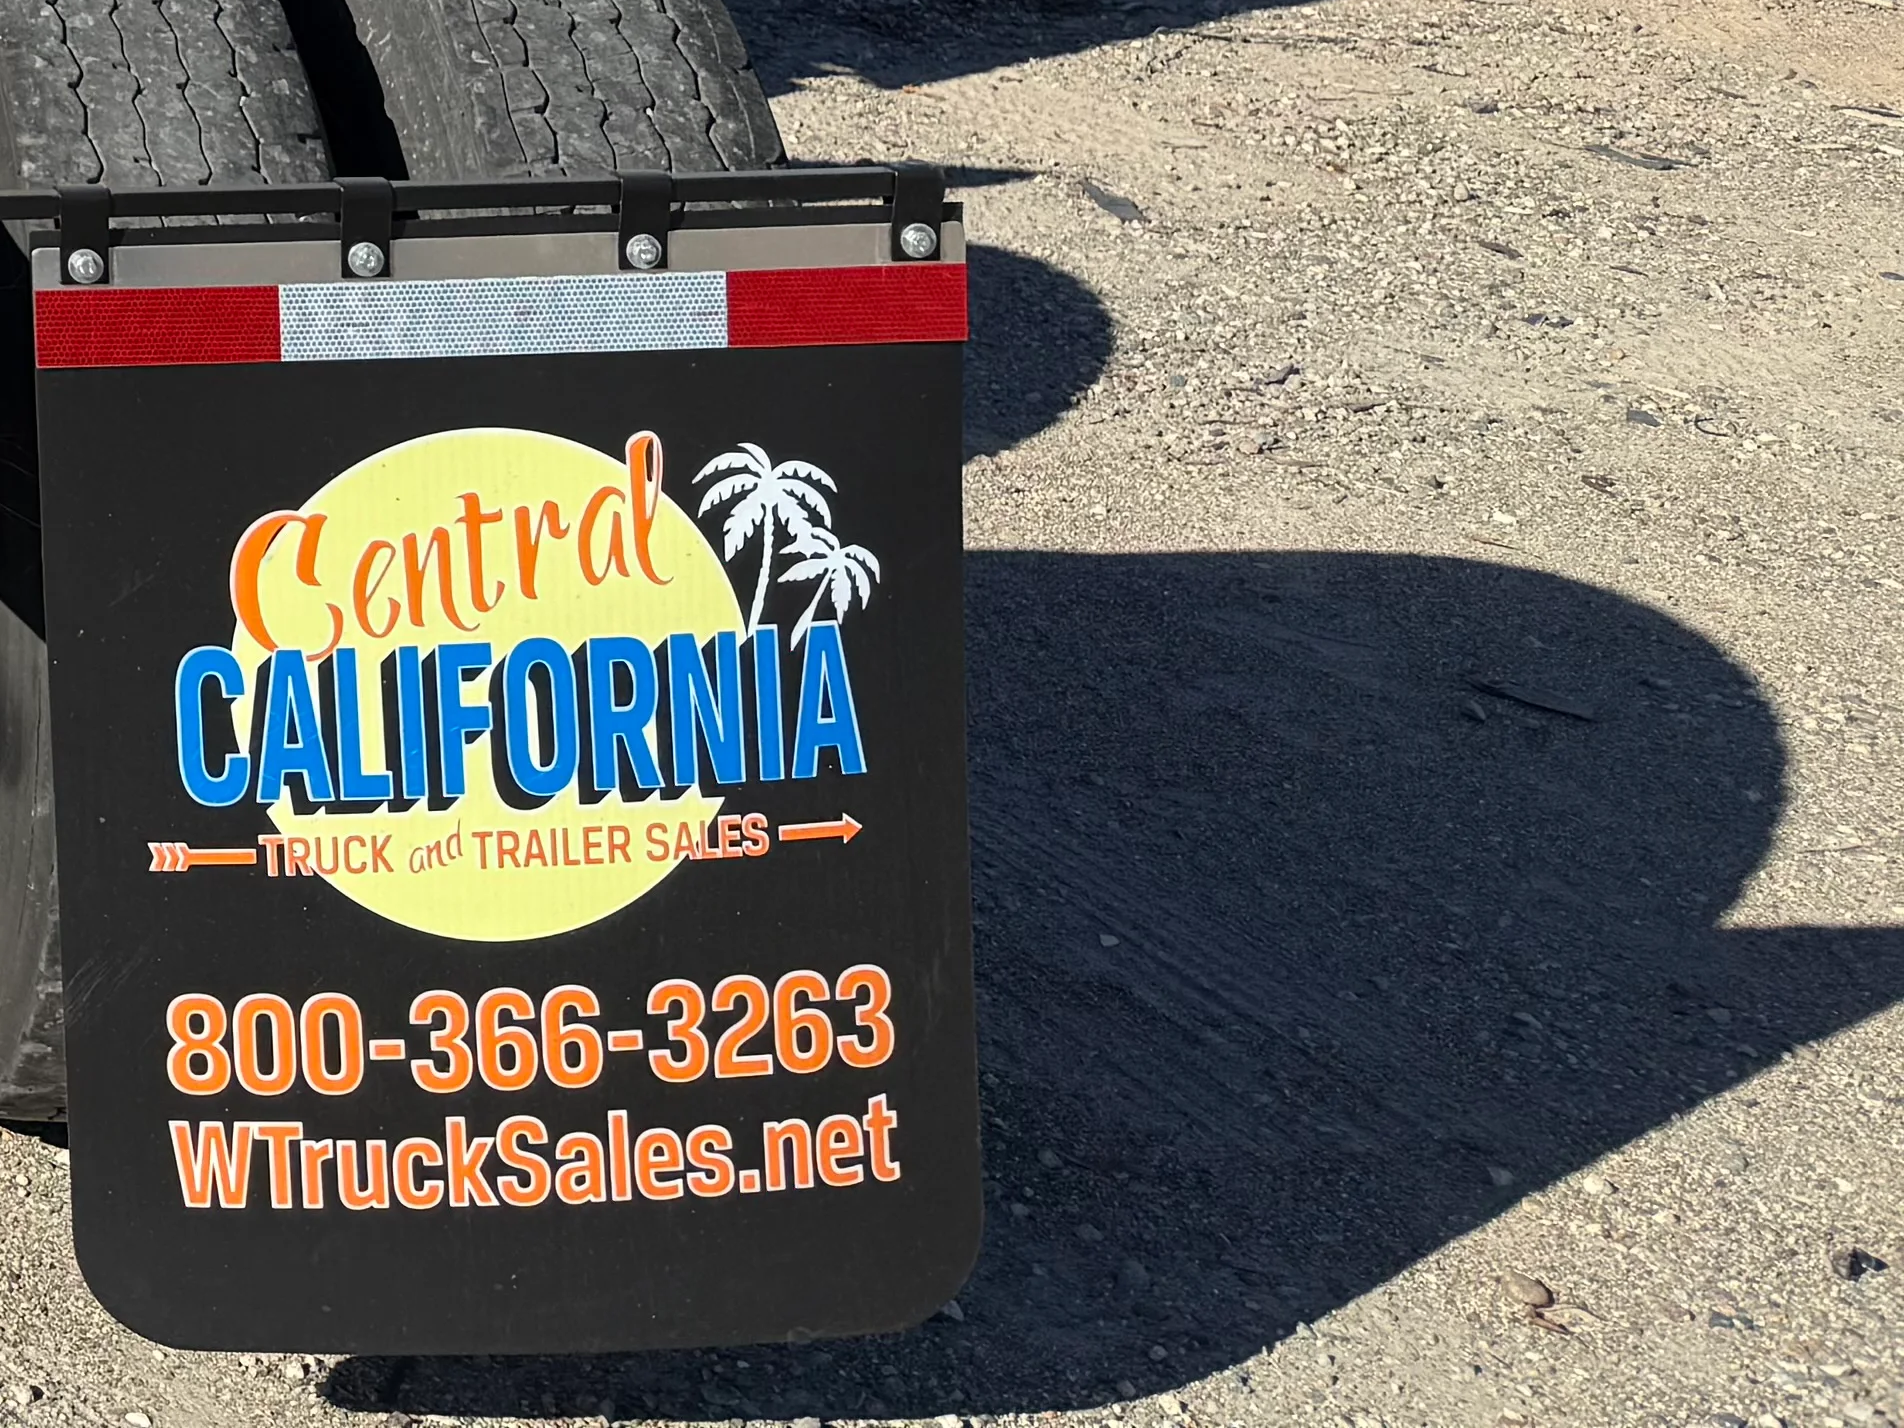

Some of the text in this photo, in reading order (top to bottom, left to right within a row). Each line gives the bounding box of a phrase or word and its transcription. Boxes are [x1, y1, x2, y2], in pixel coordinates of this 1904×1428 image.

[229, 430, 674, 662] Central
[174, 619, 868, 812] CALIFORNIA
[257, 812, 771, 879] TRUCK and TRAILER SALES
[163, 961, 897, 1098] 800-366-3263
[168, 1092, 903, 1212] WTruckSales.net
